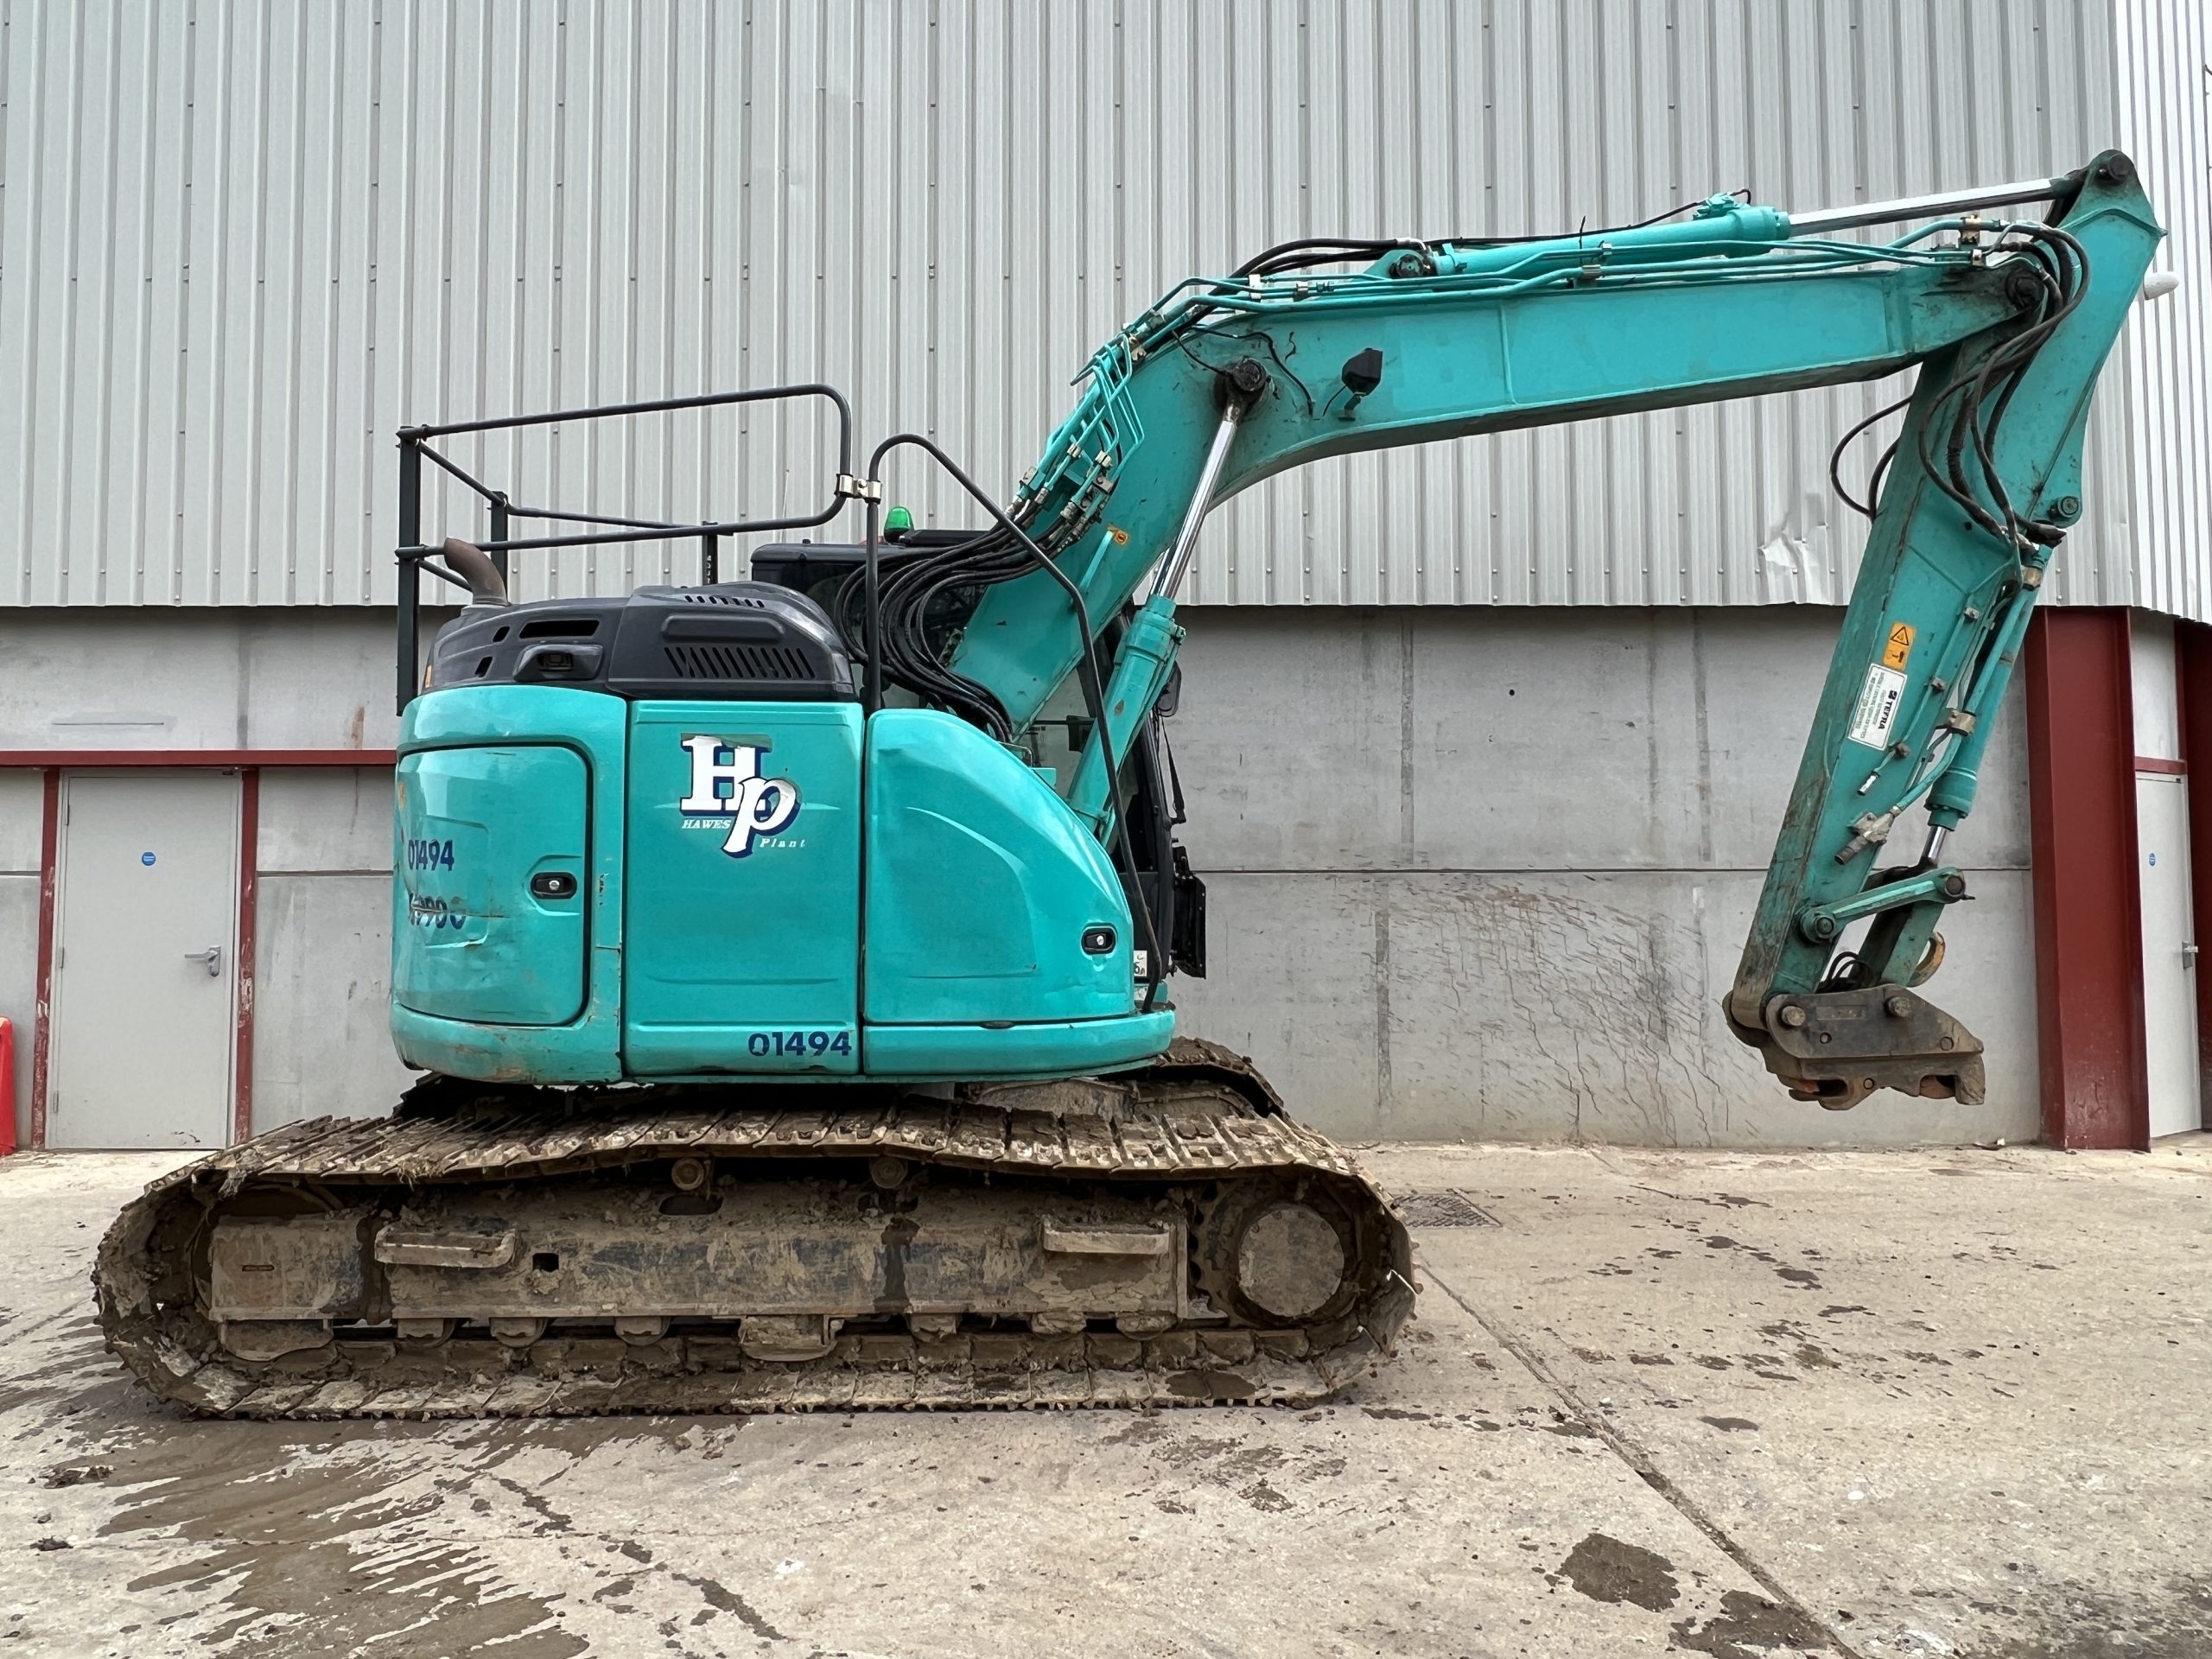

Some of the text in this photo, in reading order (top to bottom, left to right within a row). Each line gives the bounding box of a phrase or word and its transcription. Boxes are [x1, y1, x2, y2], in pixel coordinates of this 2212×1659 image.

[682, 818, 733, 830] HAWES
[760, 837, 805, 848] Plant
[408, 839, 454, 871] 01494
[748, 1031, 852, 1056] 01494
